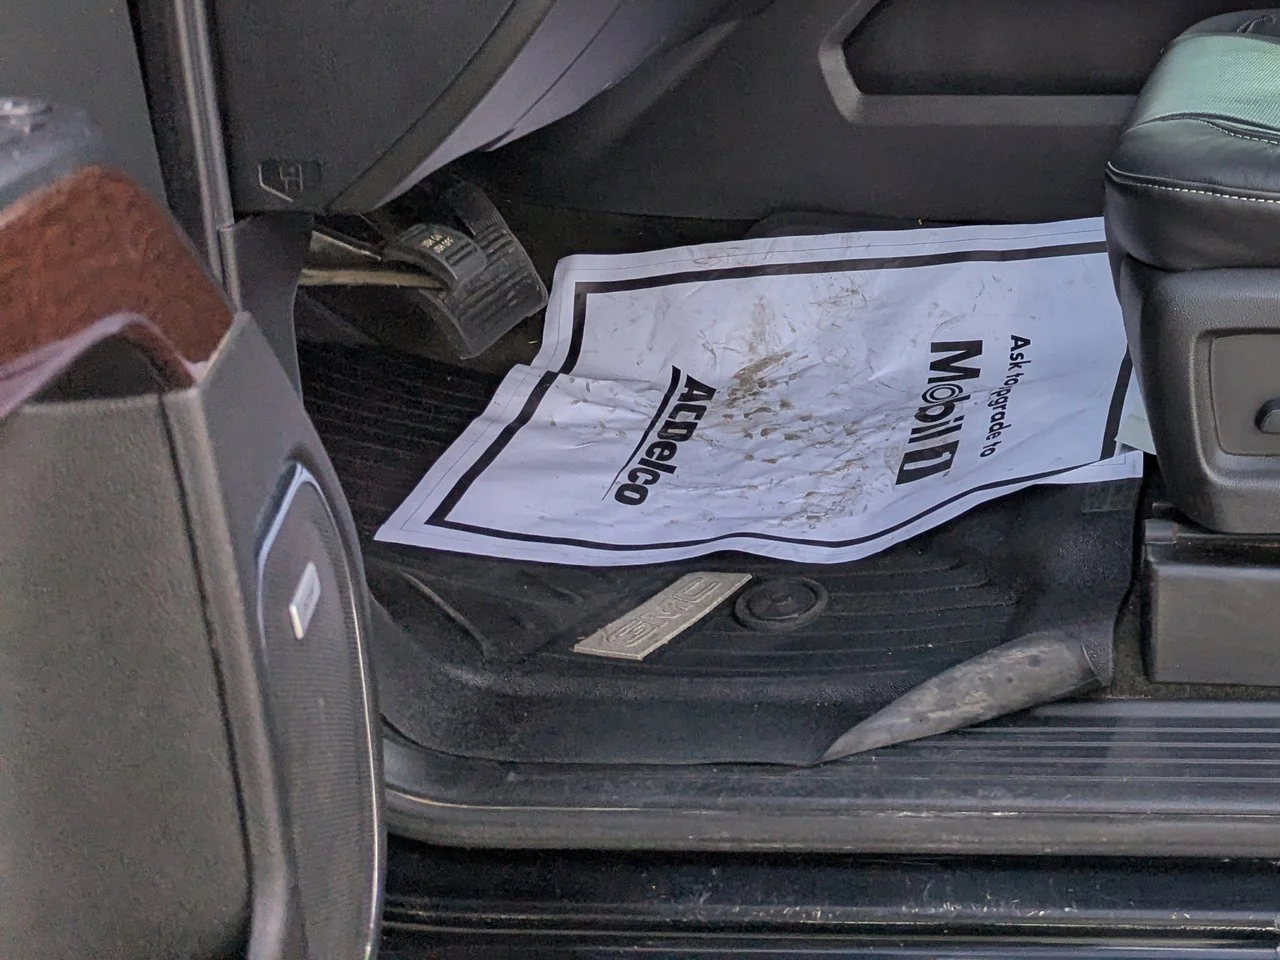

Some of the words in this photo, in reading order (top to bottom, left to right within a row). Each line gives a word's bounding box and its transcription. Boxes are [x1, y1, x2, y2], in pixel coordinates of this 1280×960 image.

[1007, 334, 1030, 371] Ask
[907, 339, 982, 444] Mobil
[1003, 372, 1023, 386] to
[985, 386, 1012, 439] pgrade
[613, 374, 716, 506] ACDelco
[979, 442, 1001, 458] to
